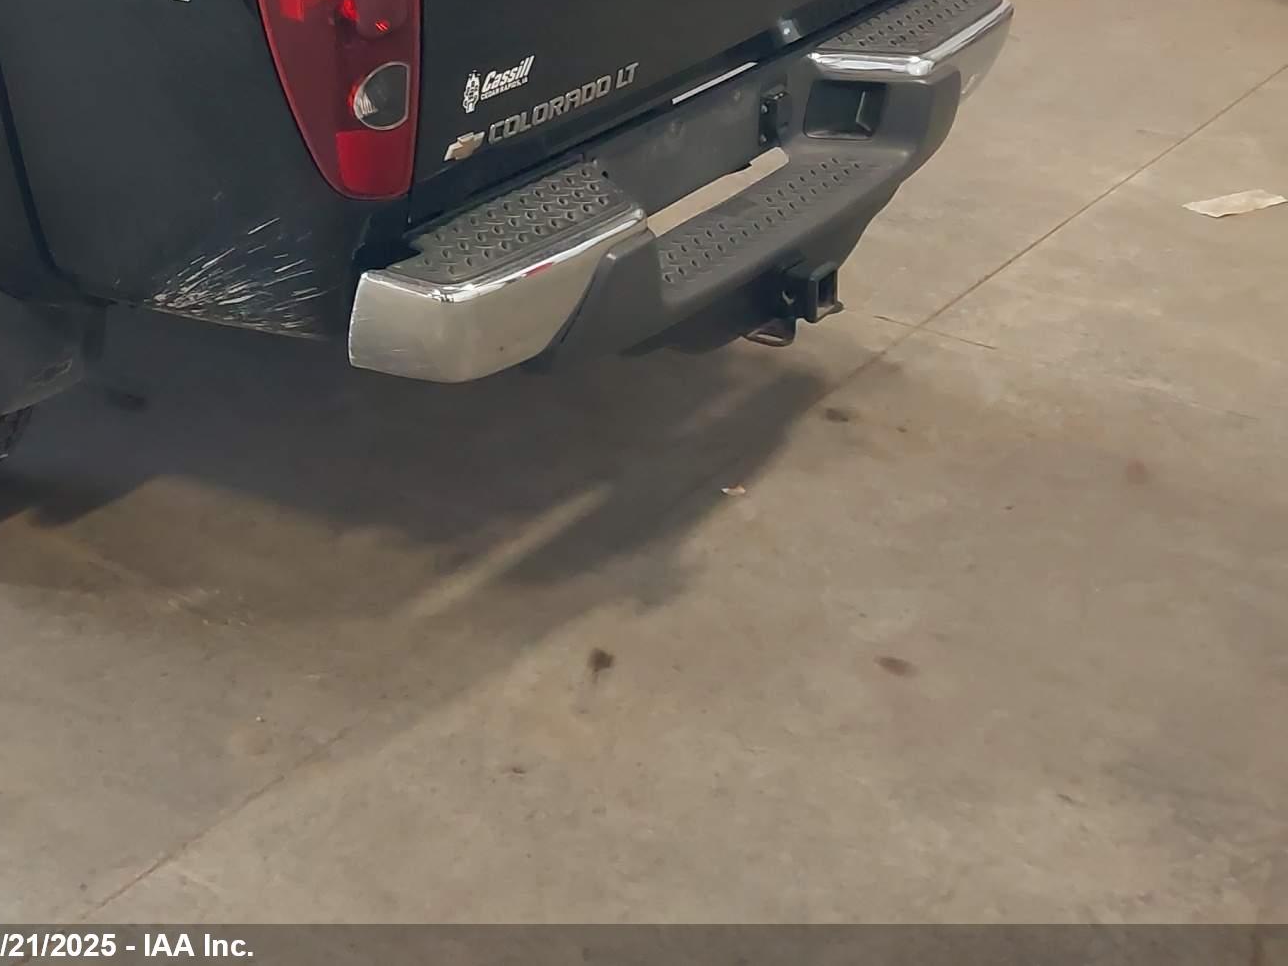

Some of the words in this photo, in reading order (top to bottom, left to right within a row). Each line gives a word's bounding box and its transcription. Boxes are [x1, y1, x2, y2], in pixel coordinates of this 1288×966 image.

[481, 54, 535, 93] Cassill
[488, 74, 613, 144] COLORADO
[615, 61, 640, 90] LT
